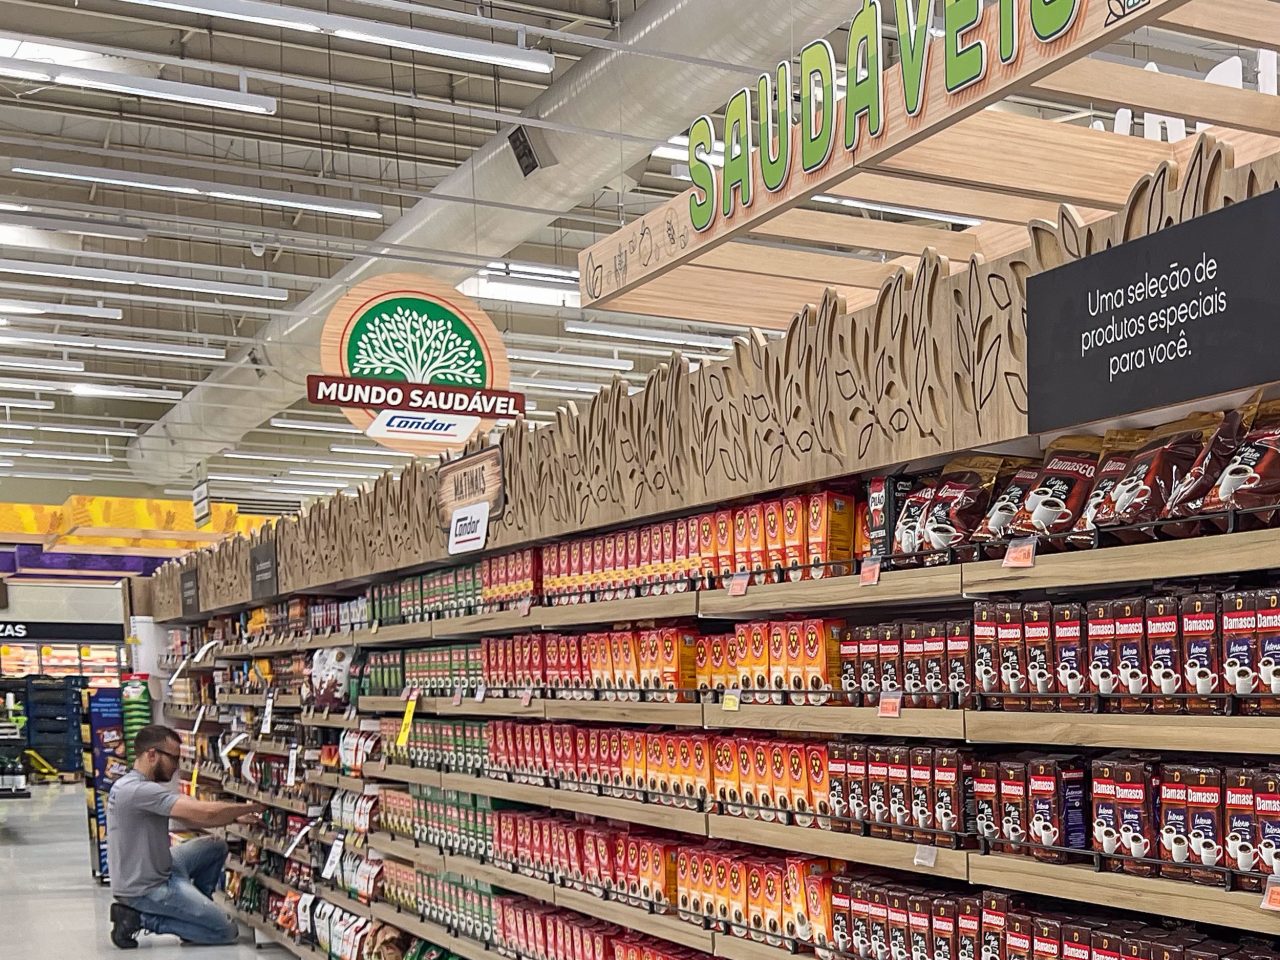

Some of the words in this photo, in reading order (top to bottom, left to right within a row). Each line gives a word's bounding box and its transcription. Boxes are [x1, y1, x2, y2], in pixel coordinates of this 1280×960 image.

[1088, 287, 1124, 316] Uma
[1127, 262, 1191, 304] seleção
[1194, 252, 1217, 283] de
[1081, 315, 1145, 357] produtos
[1148, 286, 1227, 334] especiais
[1109, 348, 1145, 382] para
[1148, 329, 1192, 365] você.
[317, 381, 404, 406] MUNDO
[408, 390, 520, 415] SAUDÁVEL
[386, 415, 457, 432] Condor
[1047, 458, 1096, 478] Damasco
[454, 516, 480, 538] Condor
[1184, 617, 1214, 631] Damasco
[1188, 789, 1219, 804] Damasco
